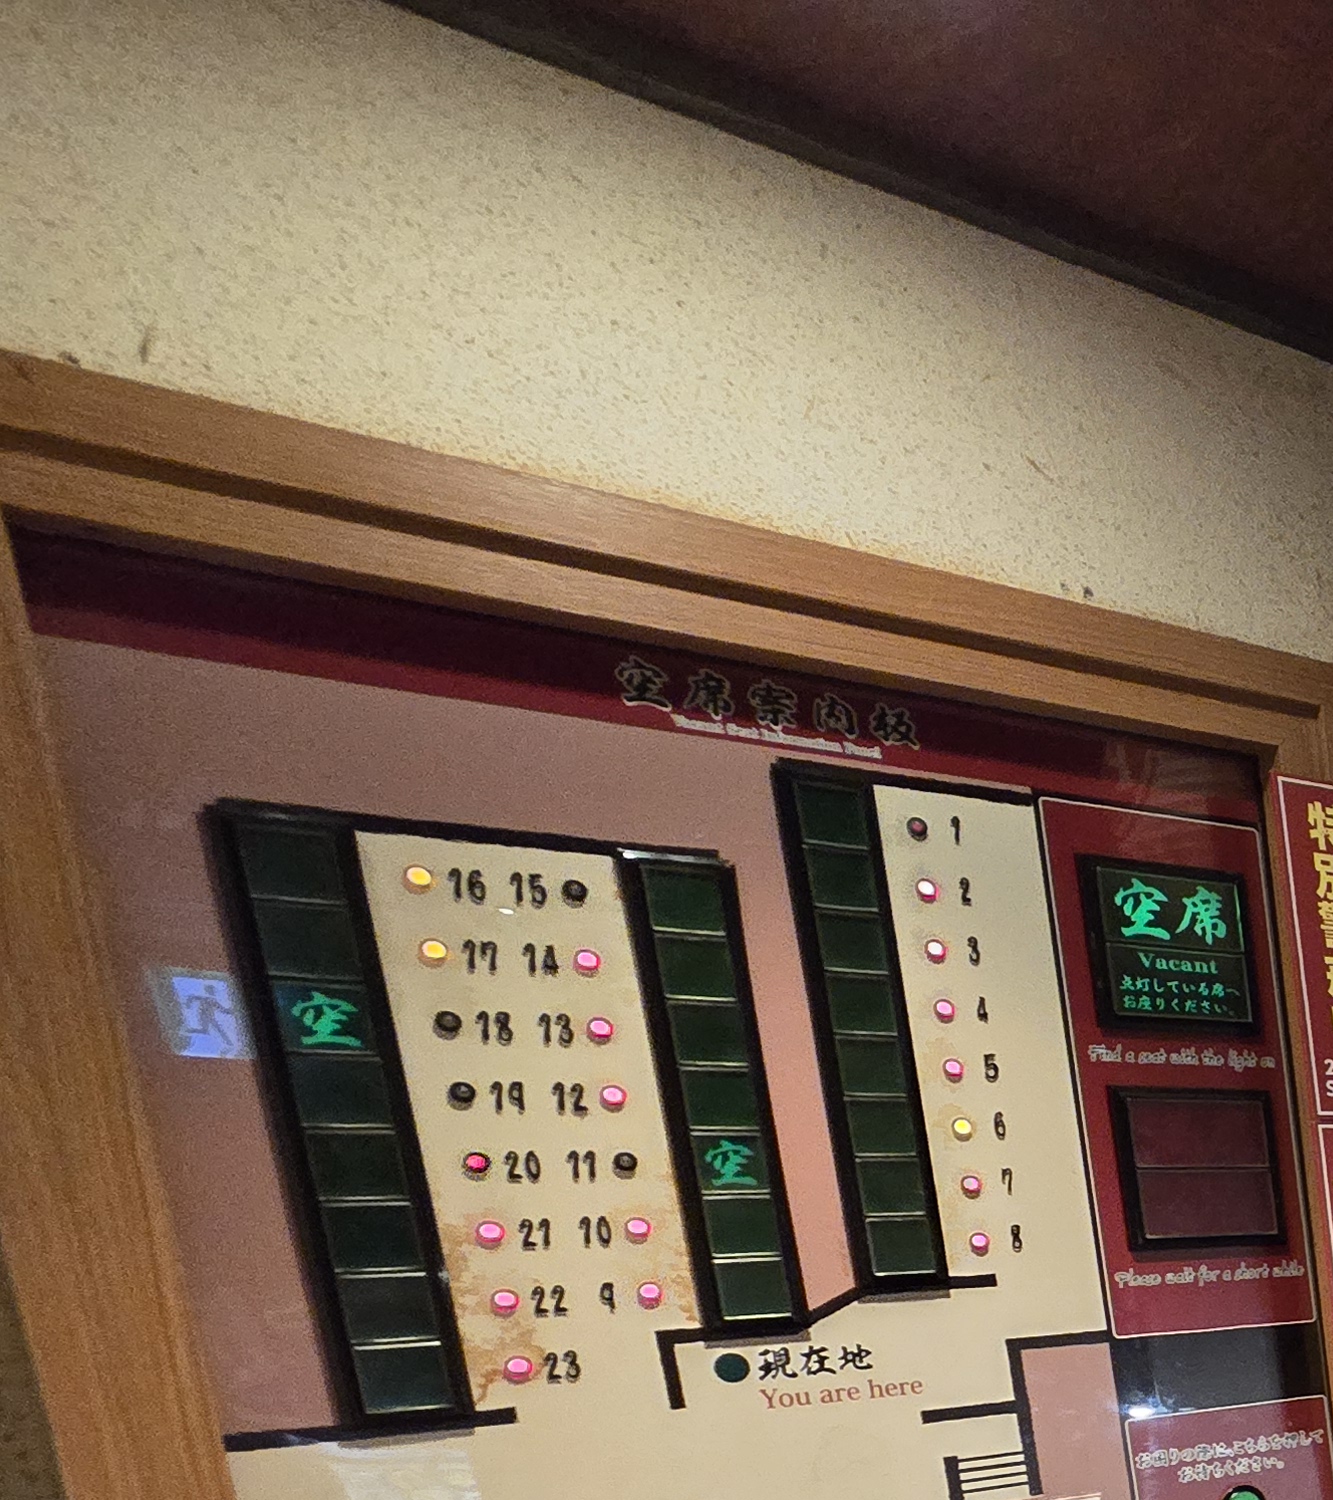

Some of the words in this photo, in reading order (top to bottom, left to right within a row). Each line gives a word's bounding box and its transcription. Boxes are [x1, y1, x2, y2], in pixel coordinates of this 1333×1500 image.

[615, 655, 920, 750] 空席案内板
[951, 815, 961, 845] 1
[448, 867, 486, 903] 16
[510, 872, 547, 908] 15
[959, 877, 972, 906] 2
[1114, 878, 1228, 945] 空席
[462, 939, 498, 973] 17
[521, 943, 559, 976] 14
[967, 936, 981, 965] 3
[1137, 952, 1219, 974] Vacant
[1119, 974, 1241, 997] 点灯している席へ
[291, 991, 362, 1047] 空
[977, 996, 989, 1024] 4
[1122, 995, 1235, 1016] お座りください。
[475, 1010, 513, 1044] 18
[538, 1013, 574, 1046] 13
[984, 1053, 999, 1082] 5
[1088, 1044, 1122, 1062] Find
[1125, 1052, 1135, 1062] a
[1202, 1047, 1224, 1065] the
[1228, 1048, 1258, 1071] light
[1260, 1055, 1275, 1068] on
[490, 1081, 525, 1114] 19
[551, 1081, 588, 1116] 12
[994, 1111, 1006, 1141] 6
[504, 1150, 541, 1182] 20
[566, 1150, 596, 1182] 11
[704, 1140, 758, 1186] 空
[1001, 1168, 1014, 1195] 7
[518, 1218, 551, 1249] 21
[579, 1215, 612, 1247] 10
[1010, 1224, 1023, 1252] 8
[1114, 1268, 1161, 1288] Please
[1165, 1267, 1194, 1285] wait
[1198, 1265, 1220, 1286] for
[1223, 1271, 1231, 1281] a
[1234, 1262, 1269, 1281] short
[1272, 1259, 1304, 1277] while
[531, 1285, 568, 1317] 22
[600, 1282, 616, 1312] 9
[543, 1351, 581, 1382] 23
[758, 1344, 873, 1381] 現在地
[759, 1388, 812, 1409] You
[819, 1386, 861, 1404] are
[867, 1379, 923, 1399] here
[1178, 1456, 1285, 1483] お待ちください。
